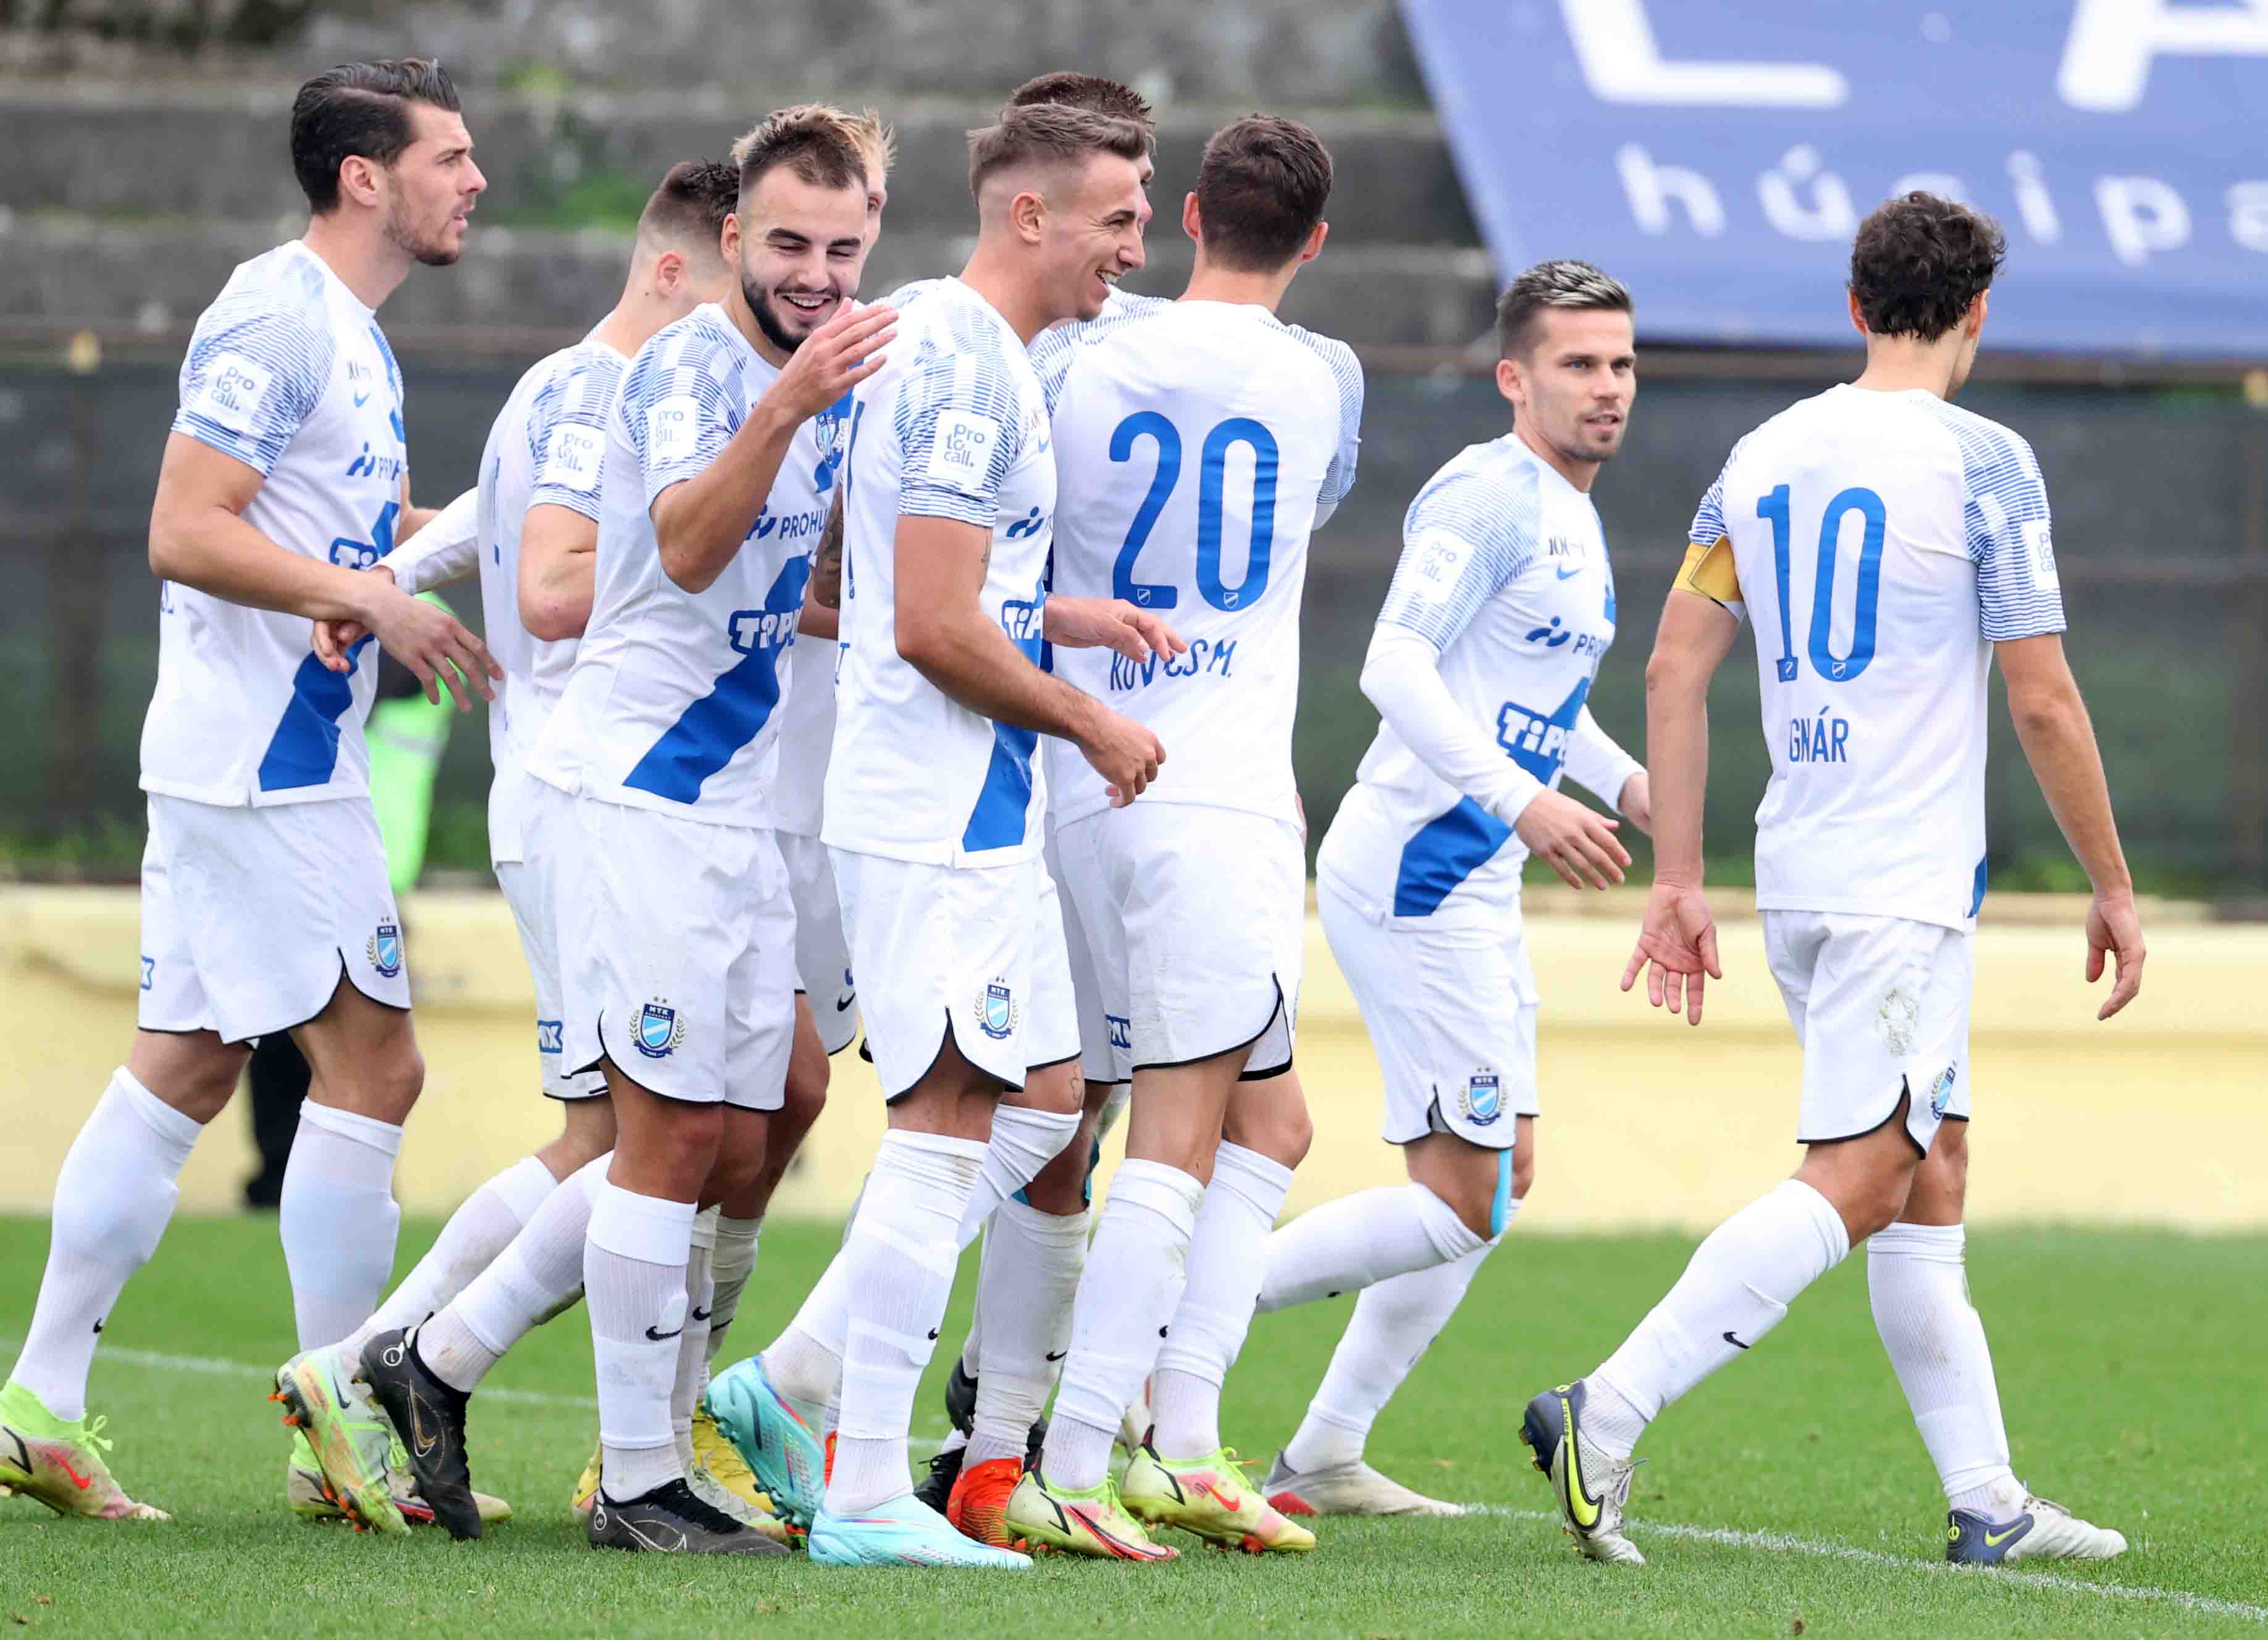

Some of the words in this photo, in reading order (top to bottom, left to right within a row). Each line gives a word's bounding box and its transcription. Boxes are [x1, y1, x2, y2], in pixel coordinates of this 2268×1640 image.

[216, 374, 233, 393] to
[226, 366, 255, 391] pro
[563, 432, 594, 450] pro
[946, 432, 965, 451] to
[954, 422, 985, 444] pro
[943, 449, 974, 467] call.
[1109, 411, 1279, 612] 20
[1757, 483, 1886, 682] 10
[1110, 638, 1208, 691] KOVCS
[649, 1006, 669, 1016] MTK
